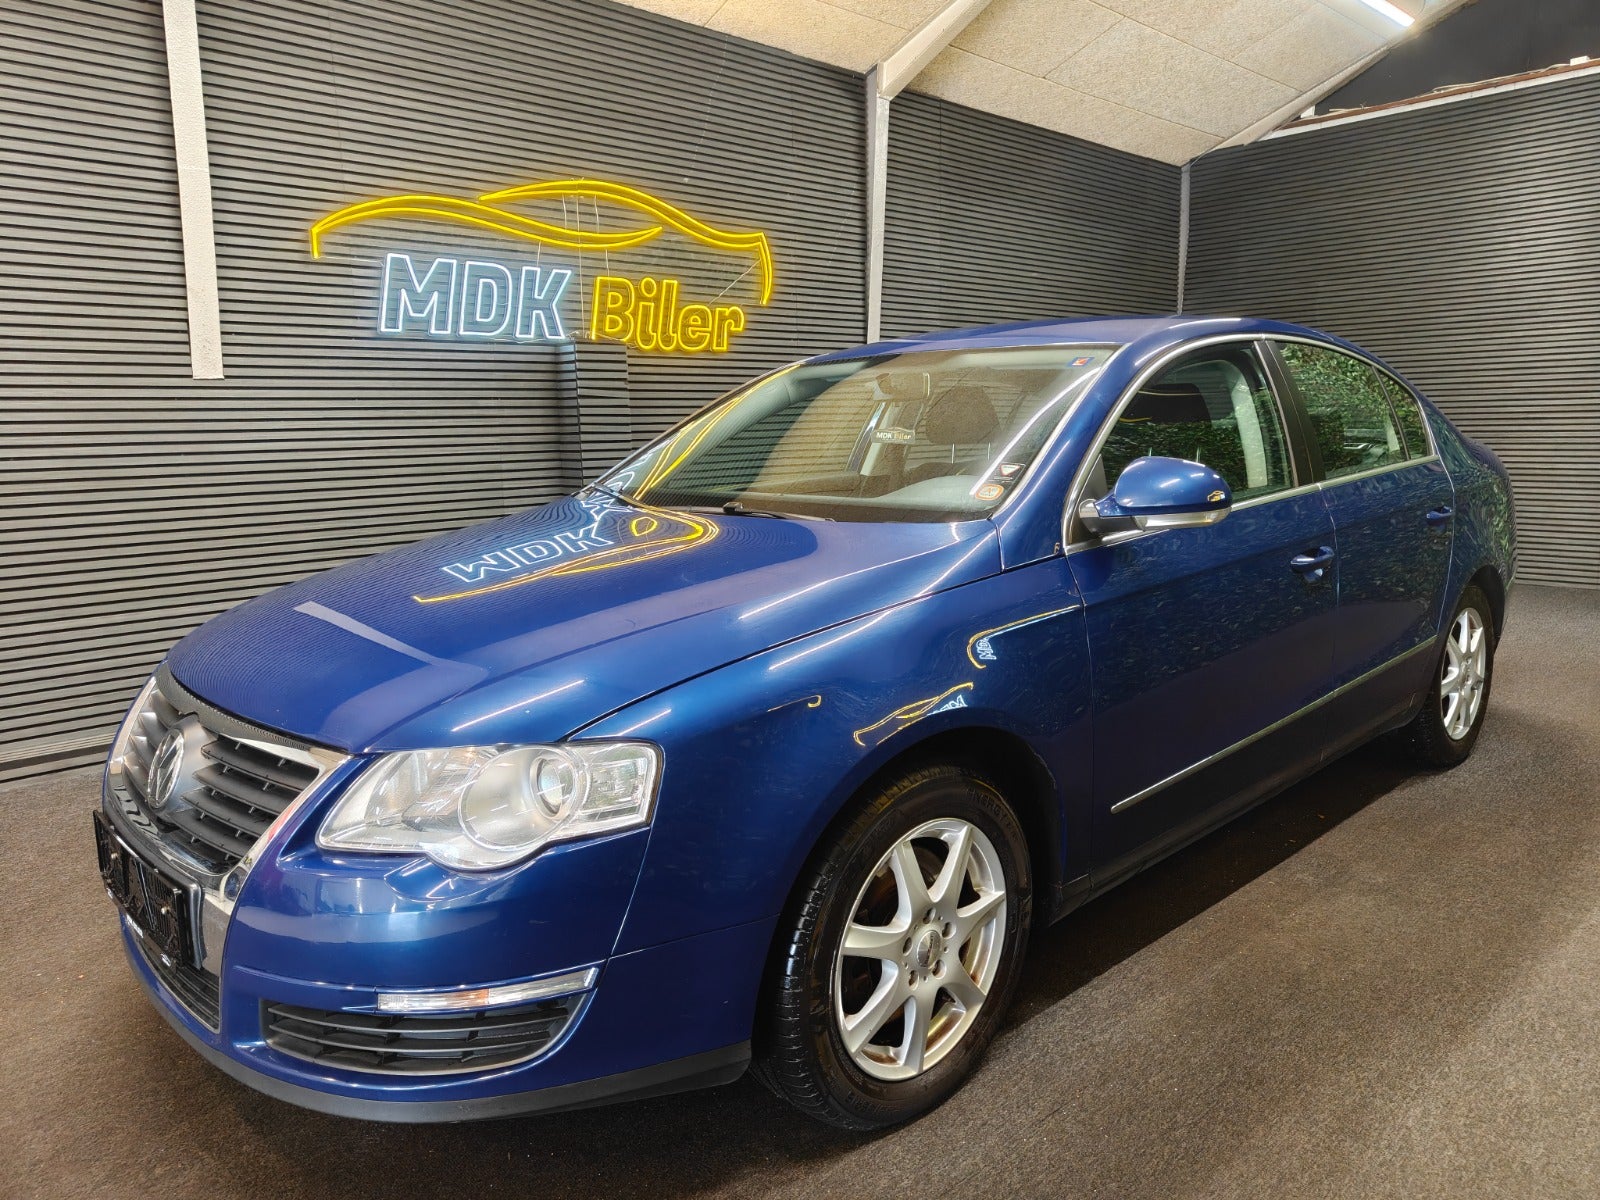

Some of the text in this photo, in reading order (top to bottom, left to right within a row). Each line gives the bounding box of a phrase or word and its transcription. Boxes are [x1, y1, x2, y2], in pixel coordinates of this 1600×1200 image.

[378, 252, 746, 351] MDK Biler
[876, 431, 892, 439] MDK
